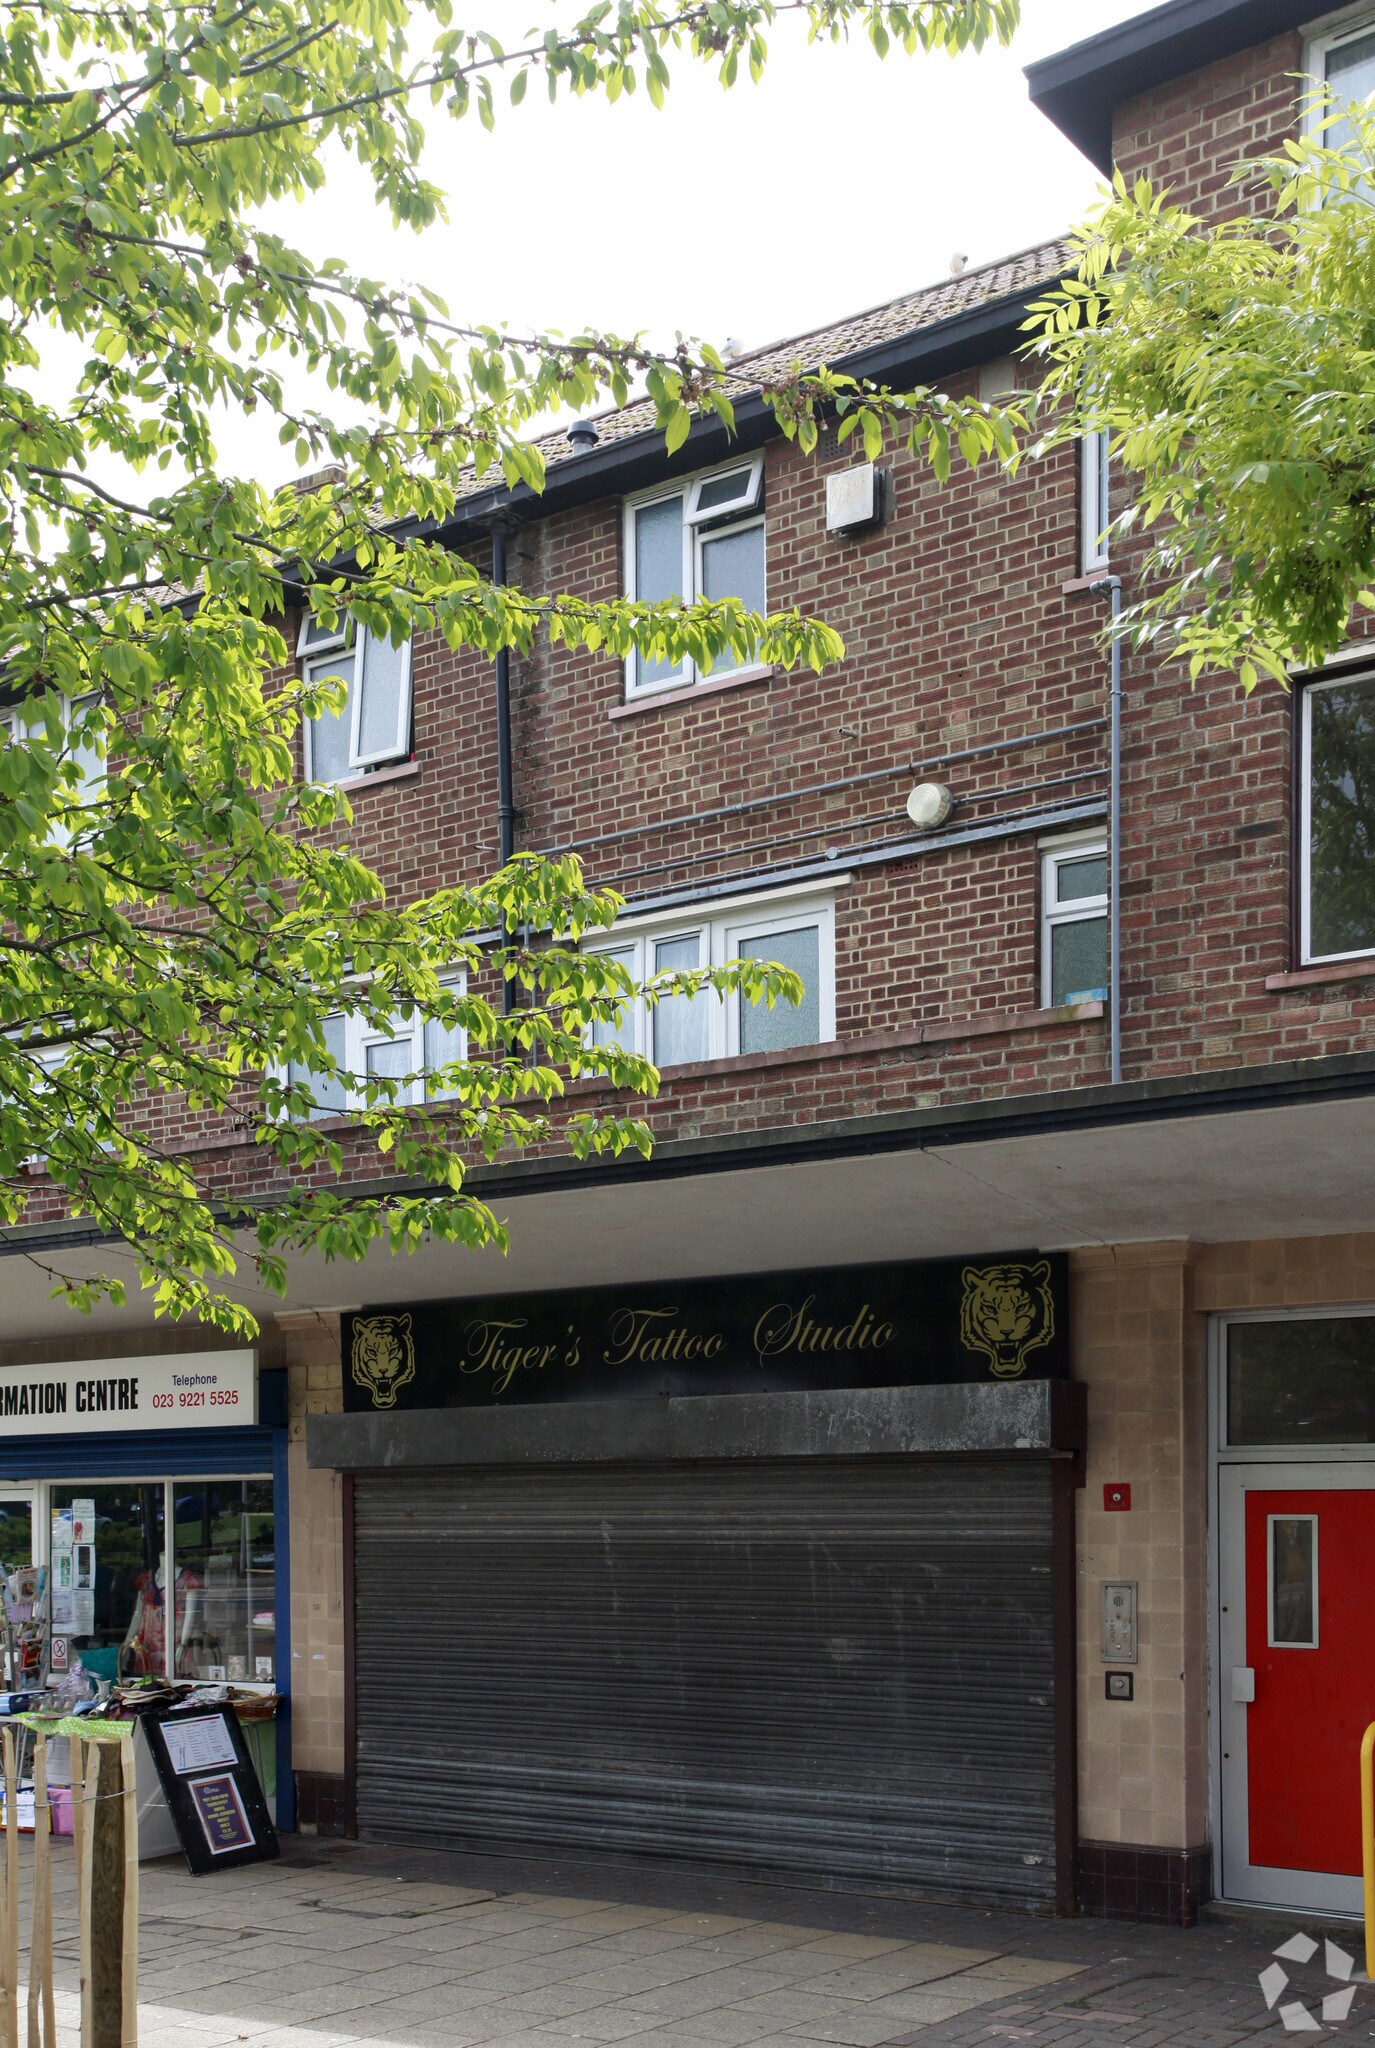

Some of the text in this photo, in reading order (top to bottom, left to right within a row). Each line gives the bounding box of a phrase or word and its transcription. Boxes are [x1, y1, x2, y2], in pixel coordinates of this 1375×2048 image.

[459, 1294, 899, 1395] Tiger's Tattoo Studio
[172, 1374, 218, 1388] Telephone
[75, 1378, 139, 1413] CENTRE
[152, 1390, 239, 1408] 023 9221 5525
